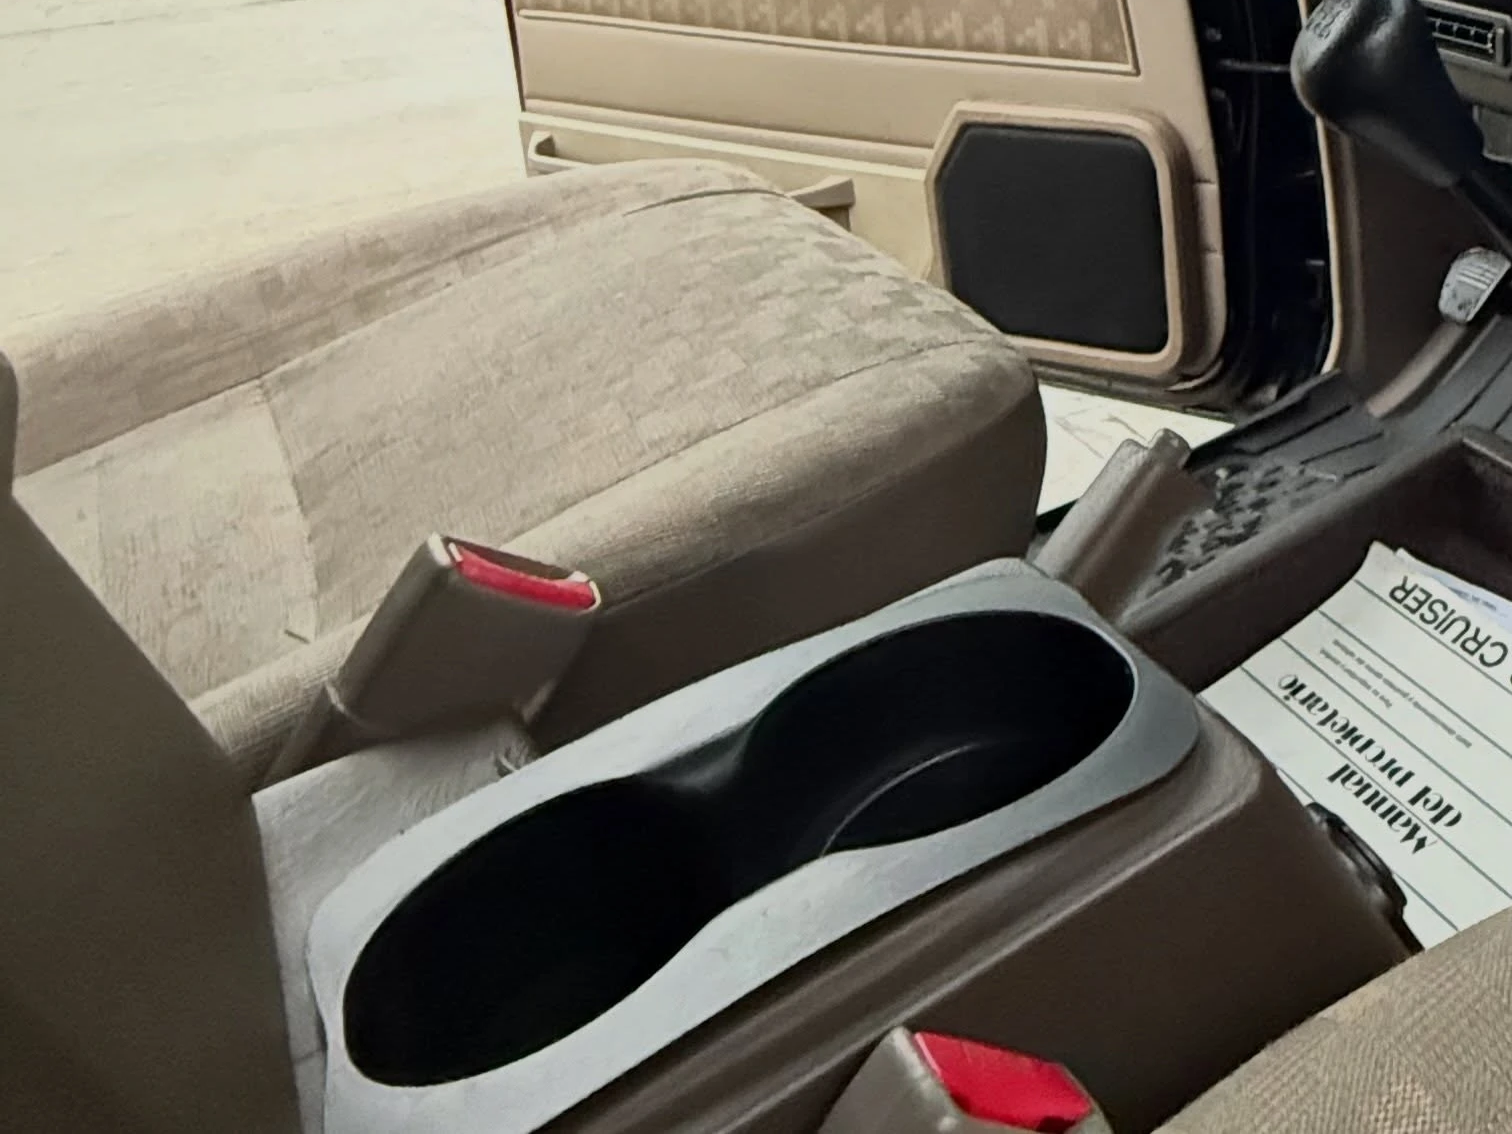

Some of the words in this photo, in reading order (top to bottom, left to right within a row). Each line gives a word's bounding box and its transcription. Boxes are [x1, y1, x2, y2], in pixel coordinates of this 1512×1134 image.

[1389, 575, 1509, 668] CRUISER
[1278, 674, 1415, 788] propietario
[1326, 763, 1438, 855] Manual
[1407, 785, 1462, 827] del
